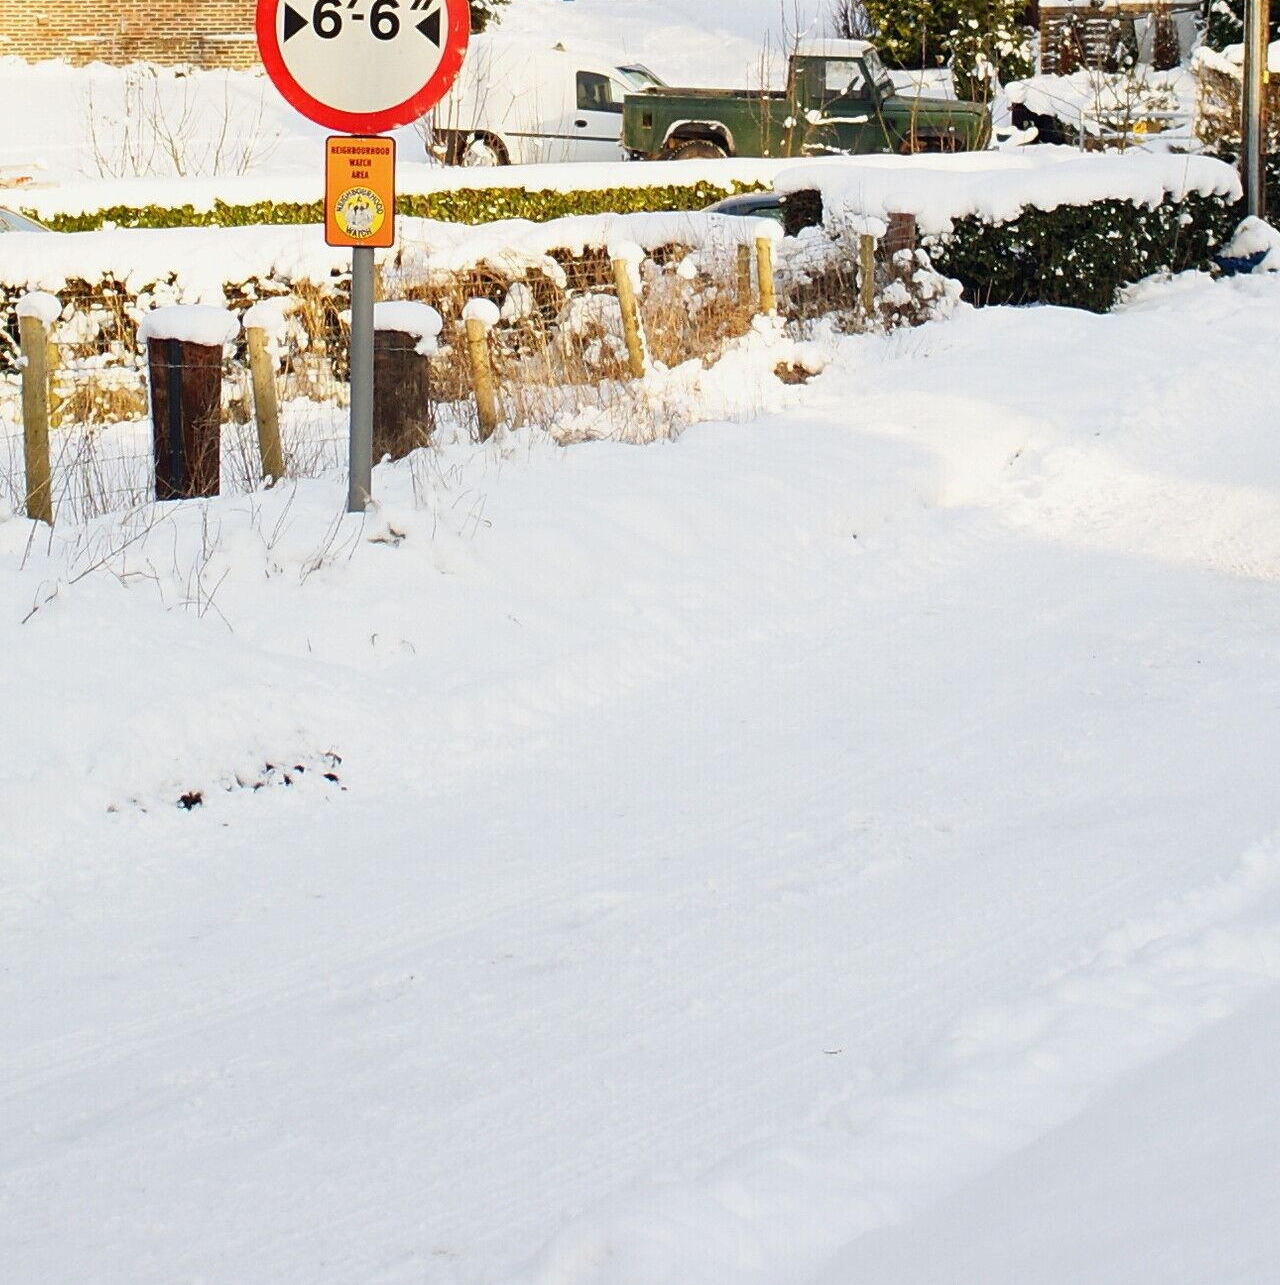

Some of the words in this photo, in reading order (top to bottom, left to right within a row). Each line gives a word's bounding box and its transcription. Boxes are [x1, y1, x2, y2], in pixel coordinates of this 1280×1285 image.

[331, 146, 390, 155] NEIGHBOURHOOD
[349, 158, 372, 167] WATCH
[351, 171, 369, 179] AREA
[336, 187, 384, 215] NEIGHBOURHOOD
[346, 225, 372, 238] WATCH
